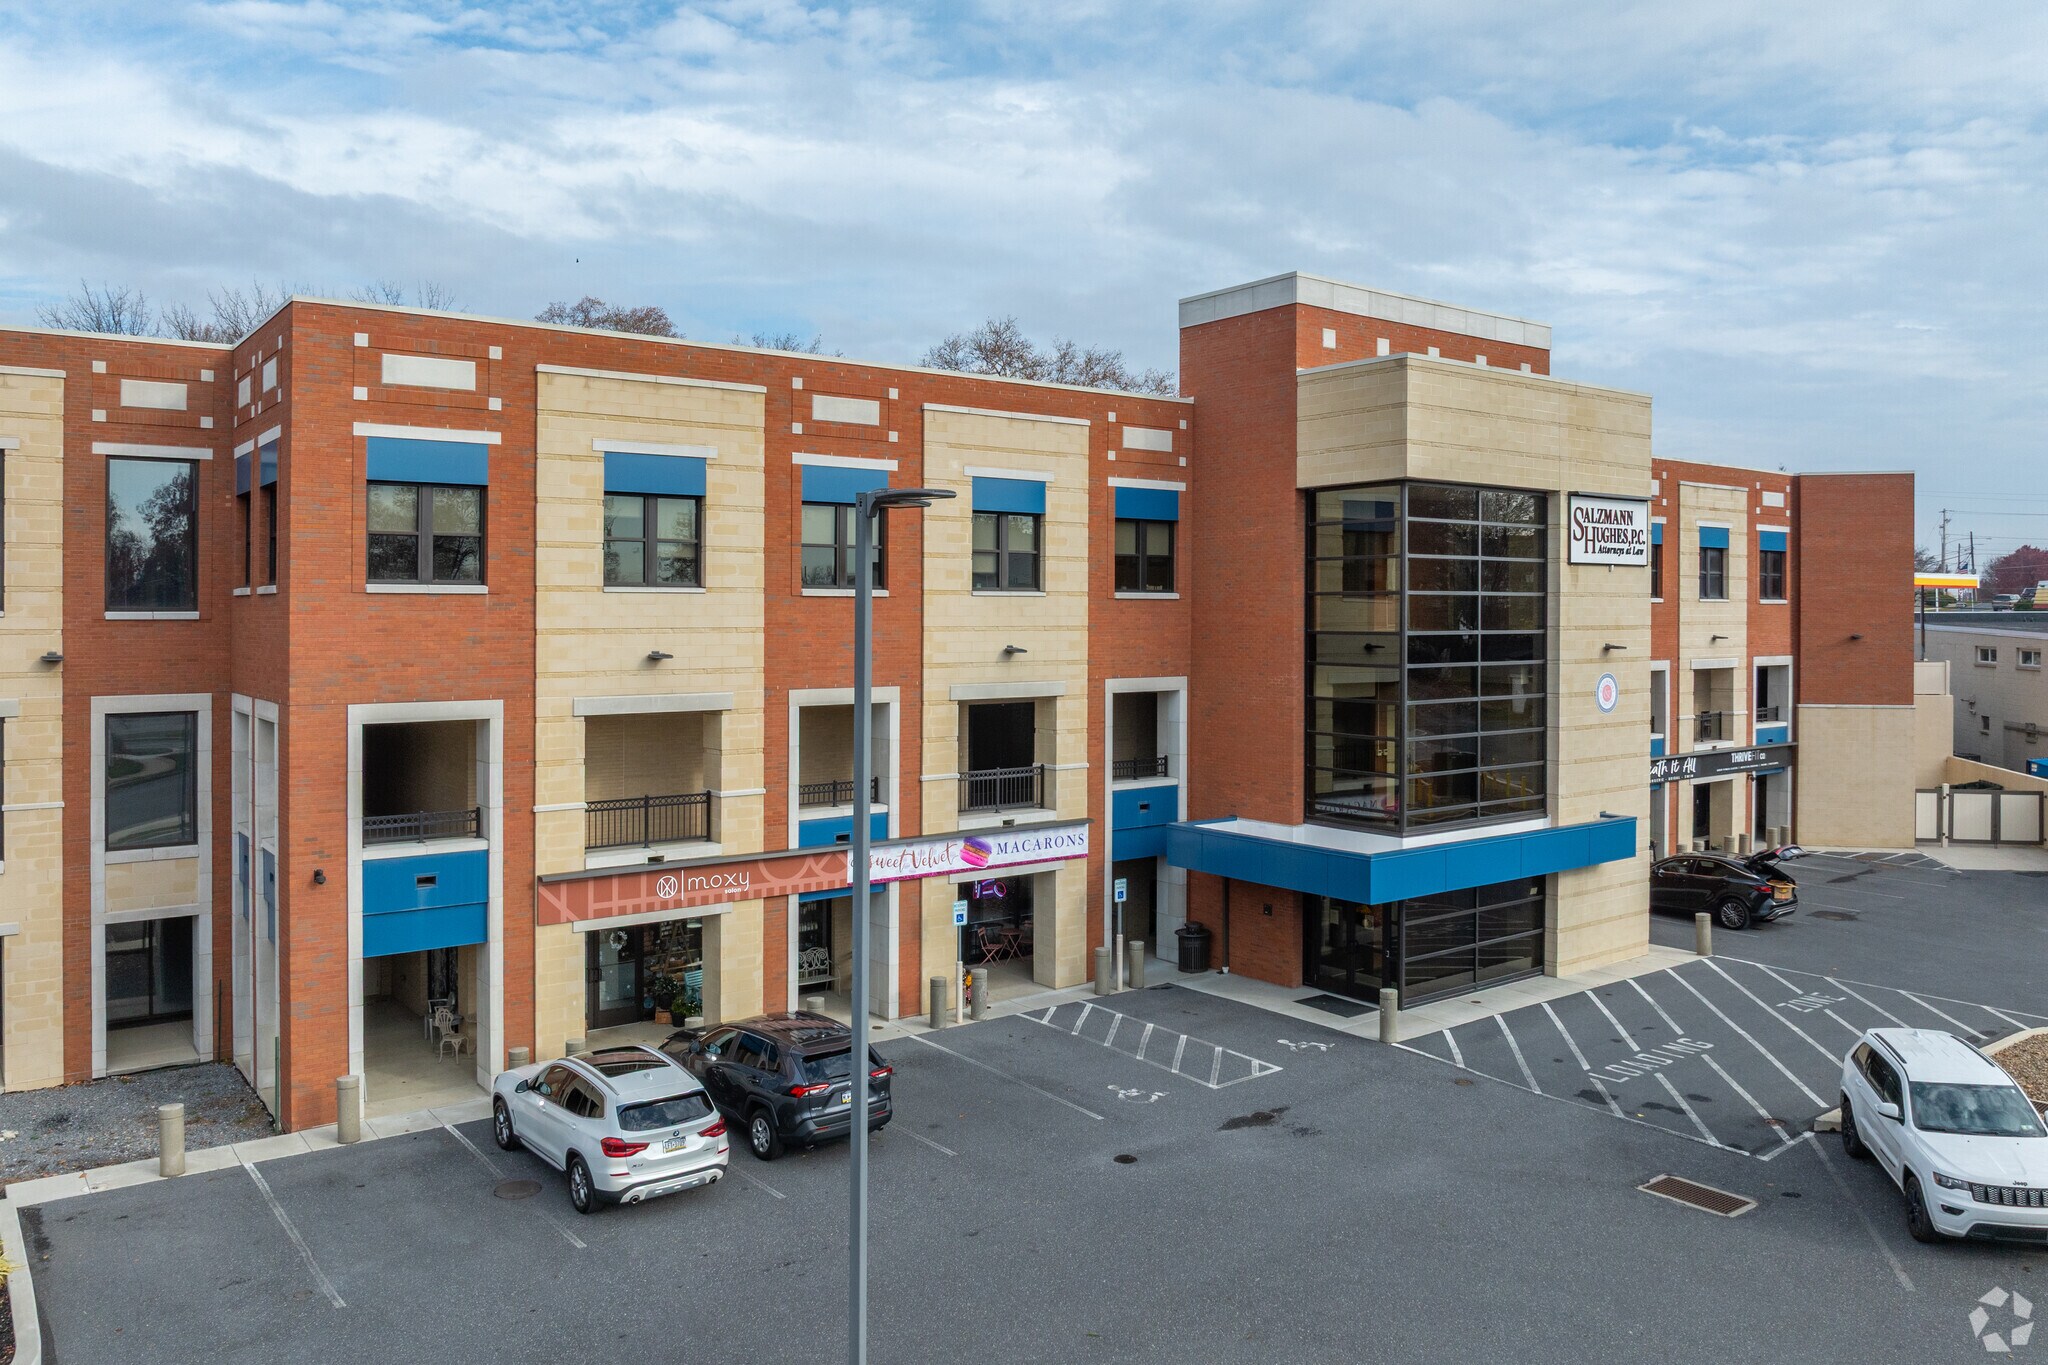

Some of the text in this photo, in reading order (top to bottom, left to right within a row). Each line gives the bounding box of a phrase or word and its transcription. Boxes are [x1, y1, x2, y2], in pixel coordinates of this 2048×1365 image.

[1573, 506, 1634, 541] SALZMANN
[1597, 545, 1645, 557] Attorneys at Law
[1670, 759, 1680, 774] It
[1682, 756, 1697, 774] All
[996, 833, 1085, 855] MACARONS
[911, 842, 959, 869] Velvet
[687, 871, 750, 892] moxy
[724, 887, 742, 895] salon
[1776, 992, 1847, 1013] ZONE
[1588, 1037, 1715, 1083] LOADING
